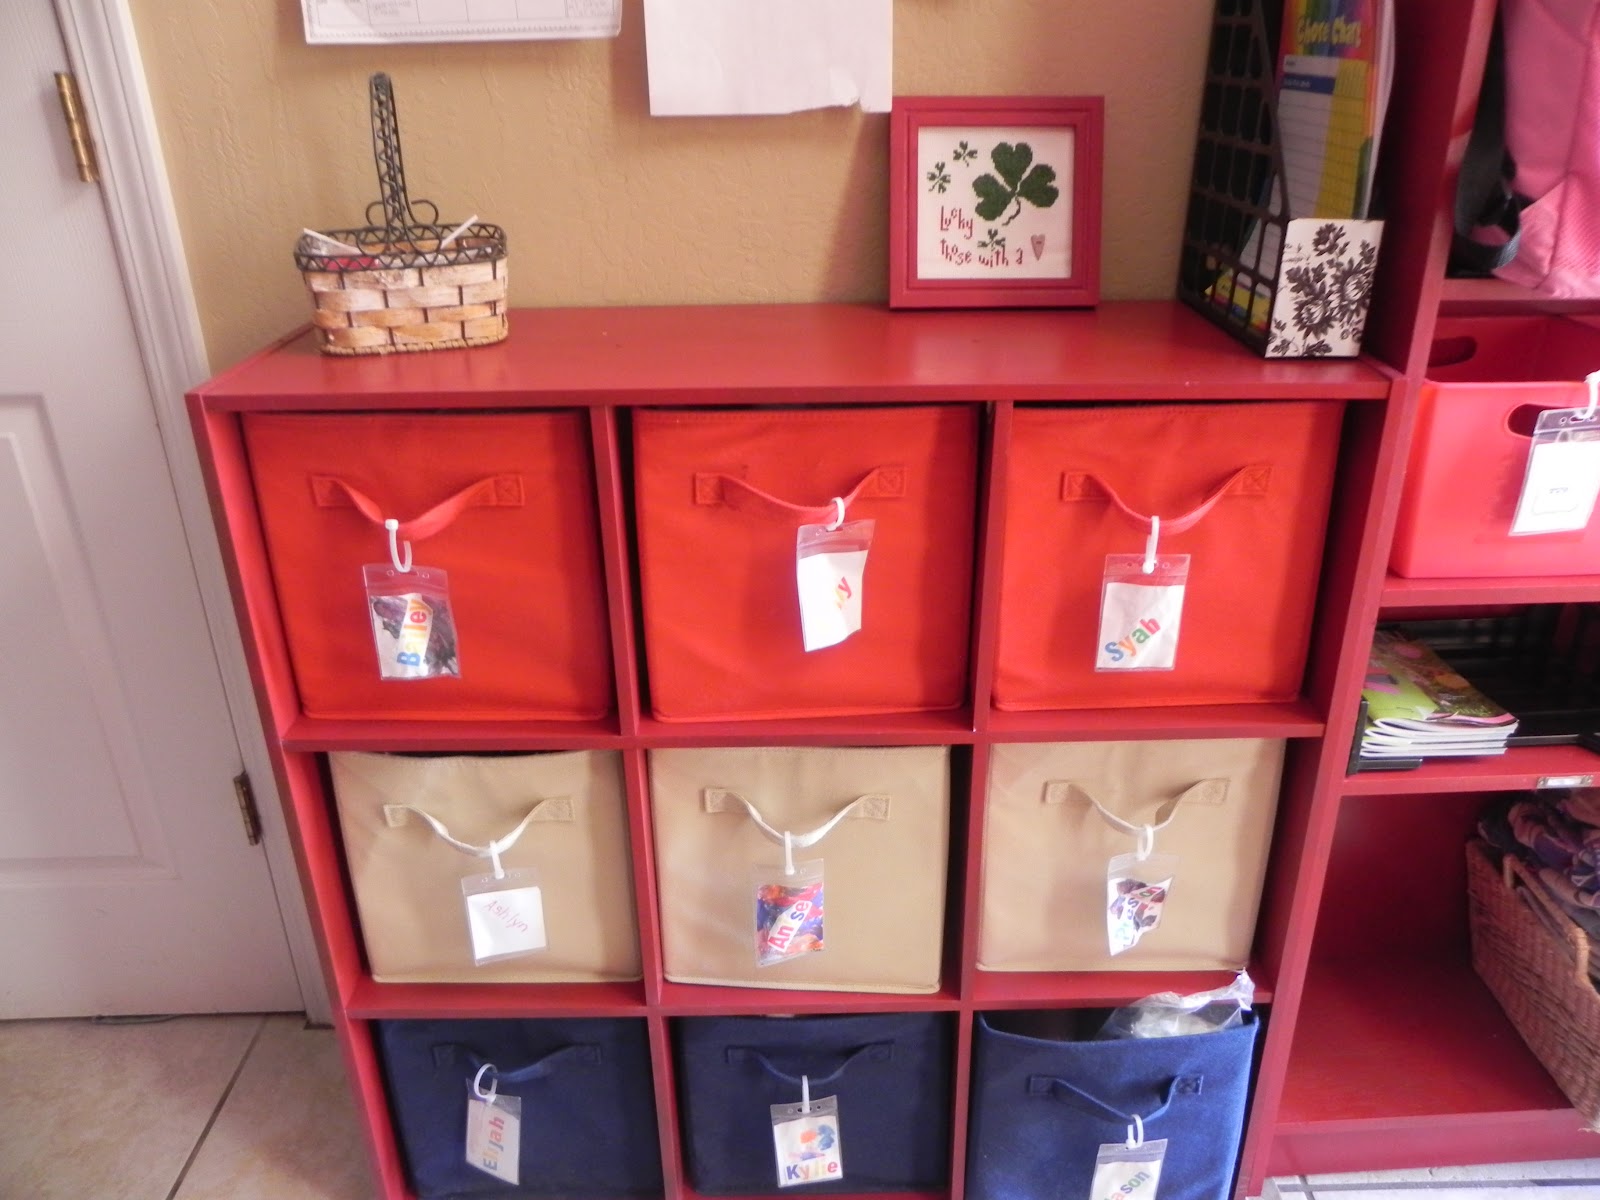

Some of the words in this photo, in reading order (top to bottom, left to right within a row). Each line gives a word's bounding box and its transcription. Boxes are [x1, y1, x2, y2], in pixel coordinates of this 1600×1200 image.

[940, 206, 973, 240] Lucky
[941, 239, 972, 266] those
[979, 243, 1009, 268] with
[1016, 247, 1023, 265] a
[1105, 618, 1161, 662] Syab
[786, 1161, 838, 1181] Kylie
